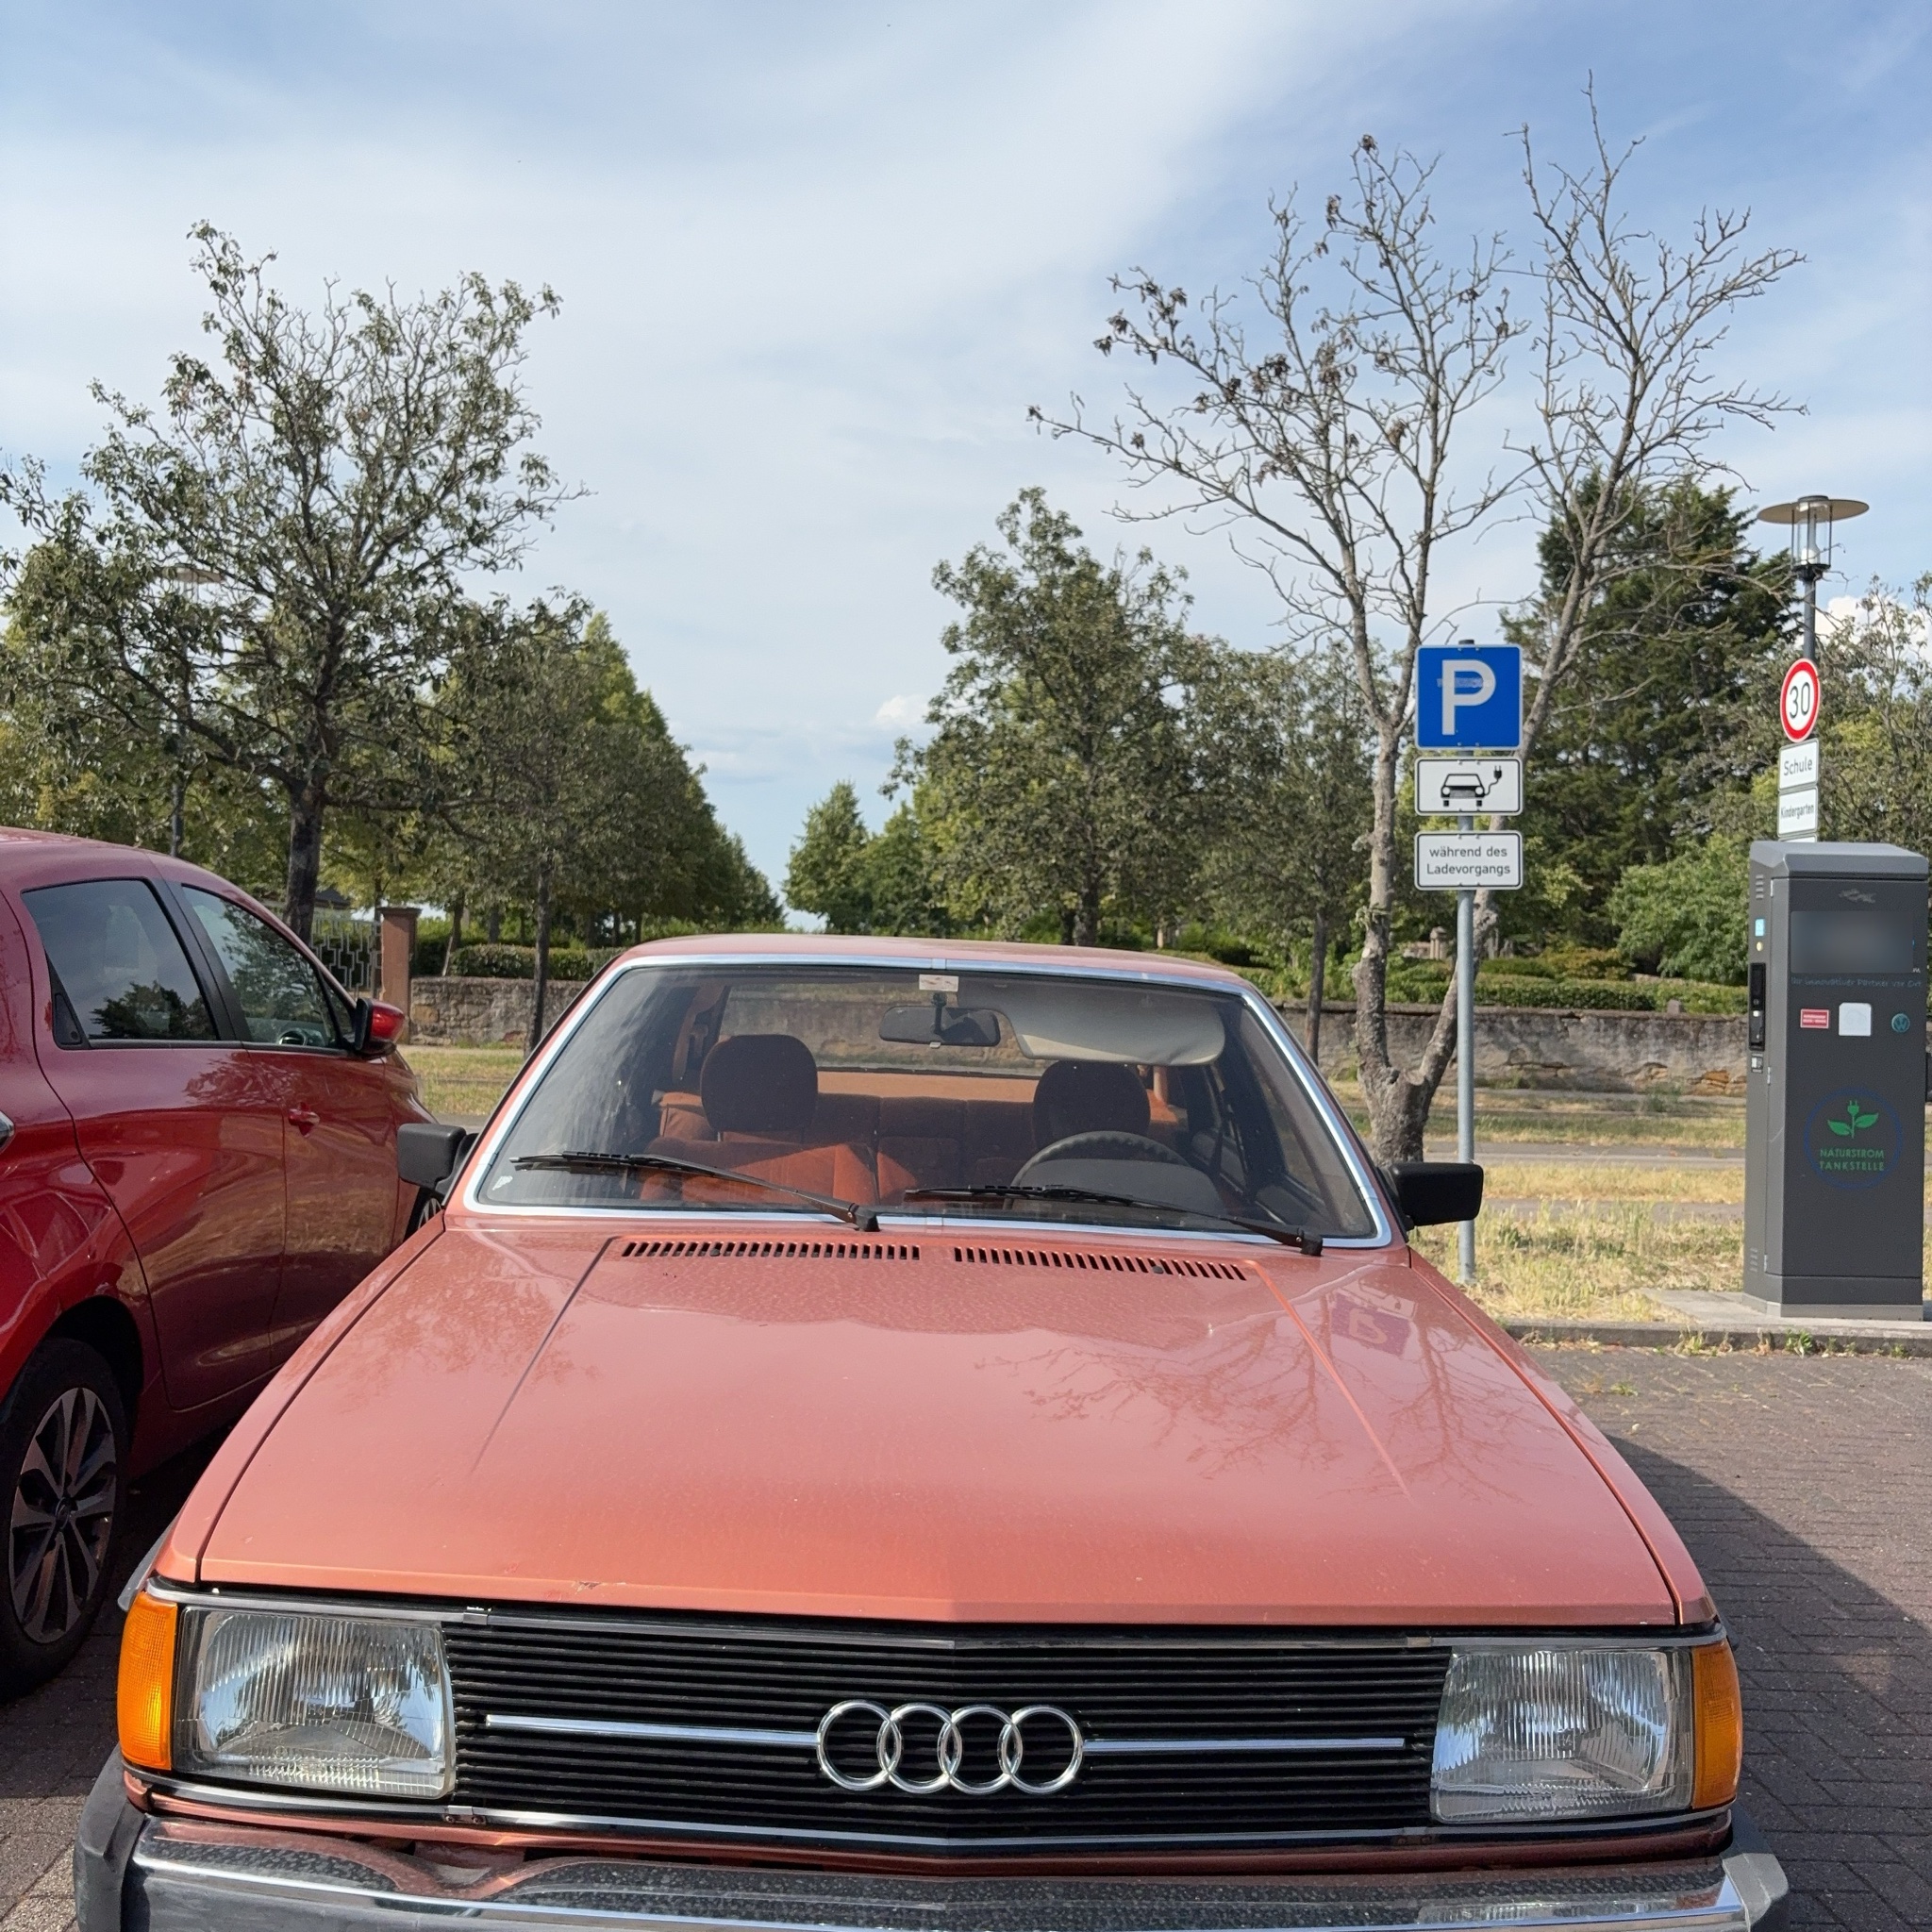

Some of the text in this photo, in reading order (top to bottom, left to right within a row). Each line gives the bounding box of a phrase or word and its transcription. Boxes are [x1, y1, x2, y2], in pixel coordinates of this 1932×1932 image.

[1442, 659, 1496, 735] P
[1790, 682, 1810, 719] 30
[1783, 757, 1813, 775] Schule
[1780, 804, 1814, 820] Kindergarten
[1429, 846, 1507, 857] während des
[1426, 863, 1510, 876] Ladevorgangs
[1820, 1149, 1884, 1158] NATURSTROM
[1820, 1161, 1884, 1171] TANKSTELLE
